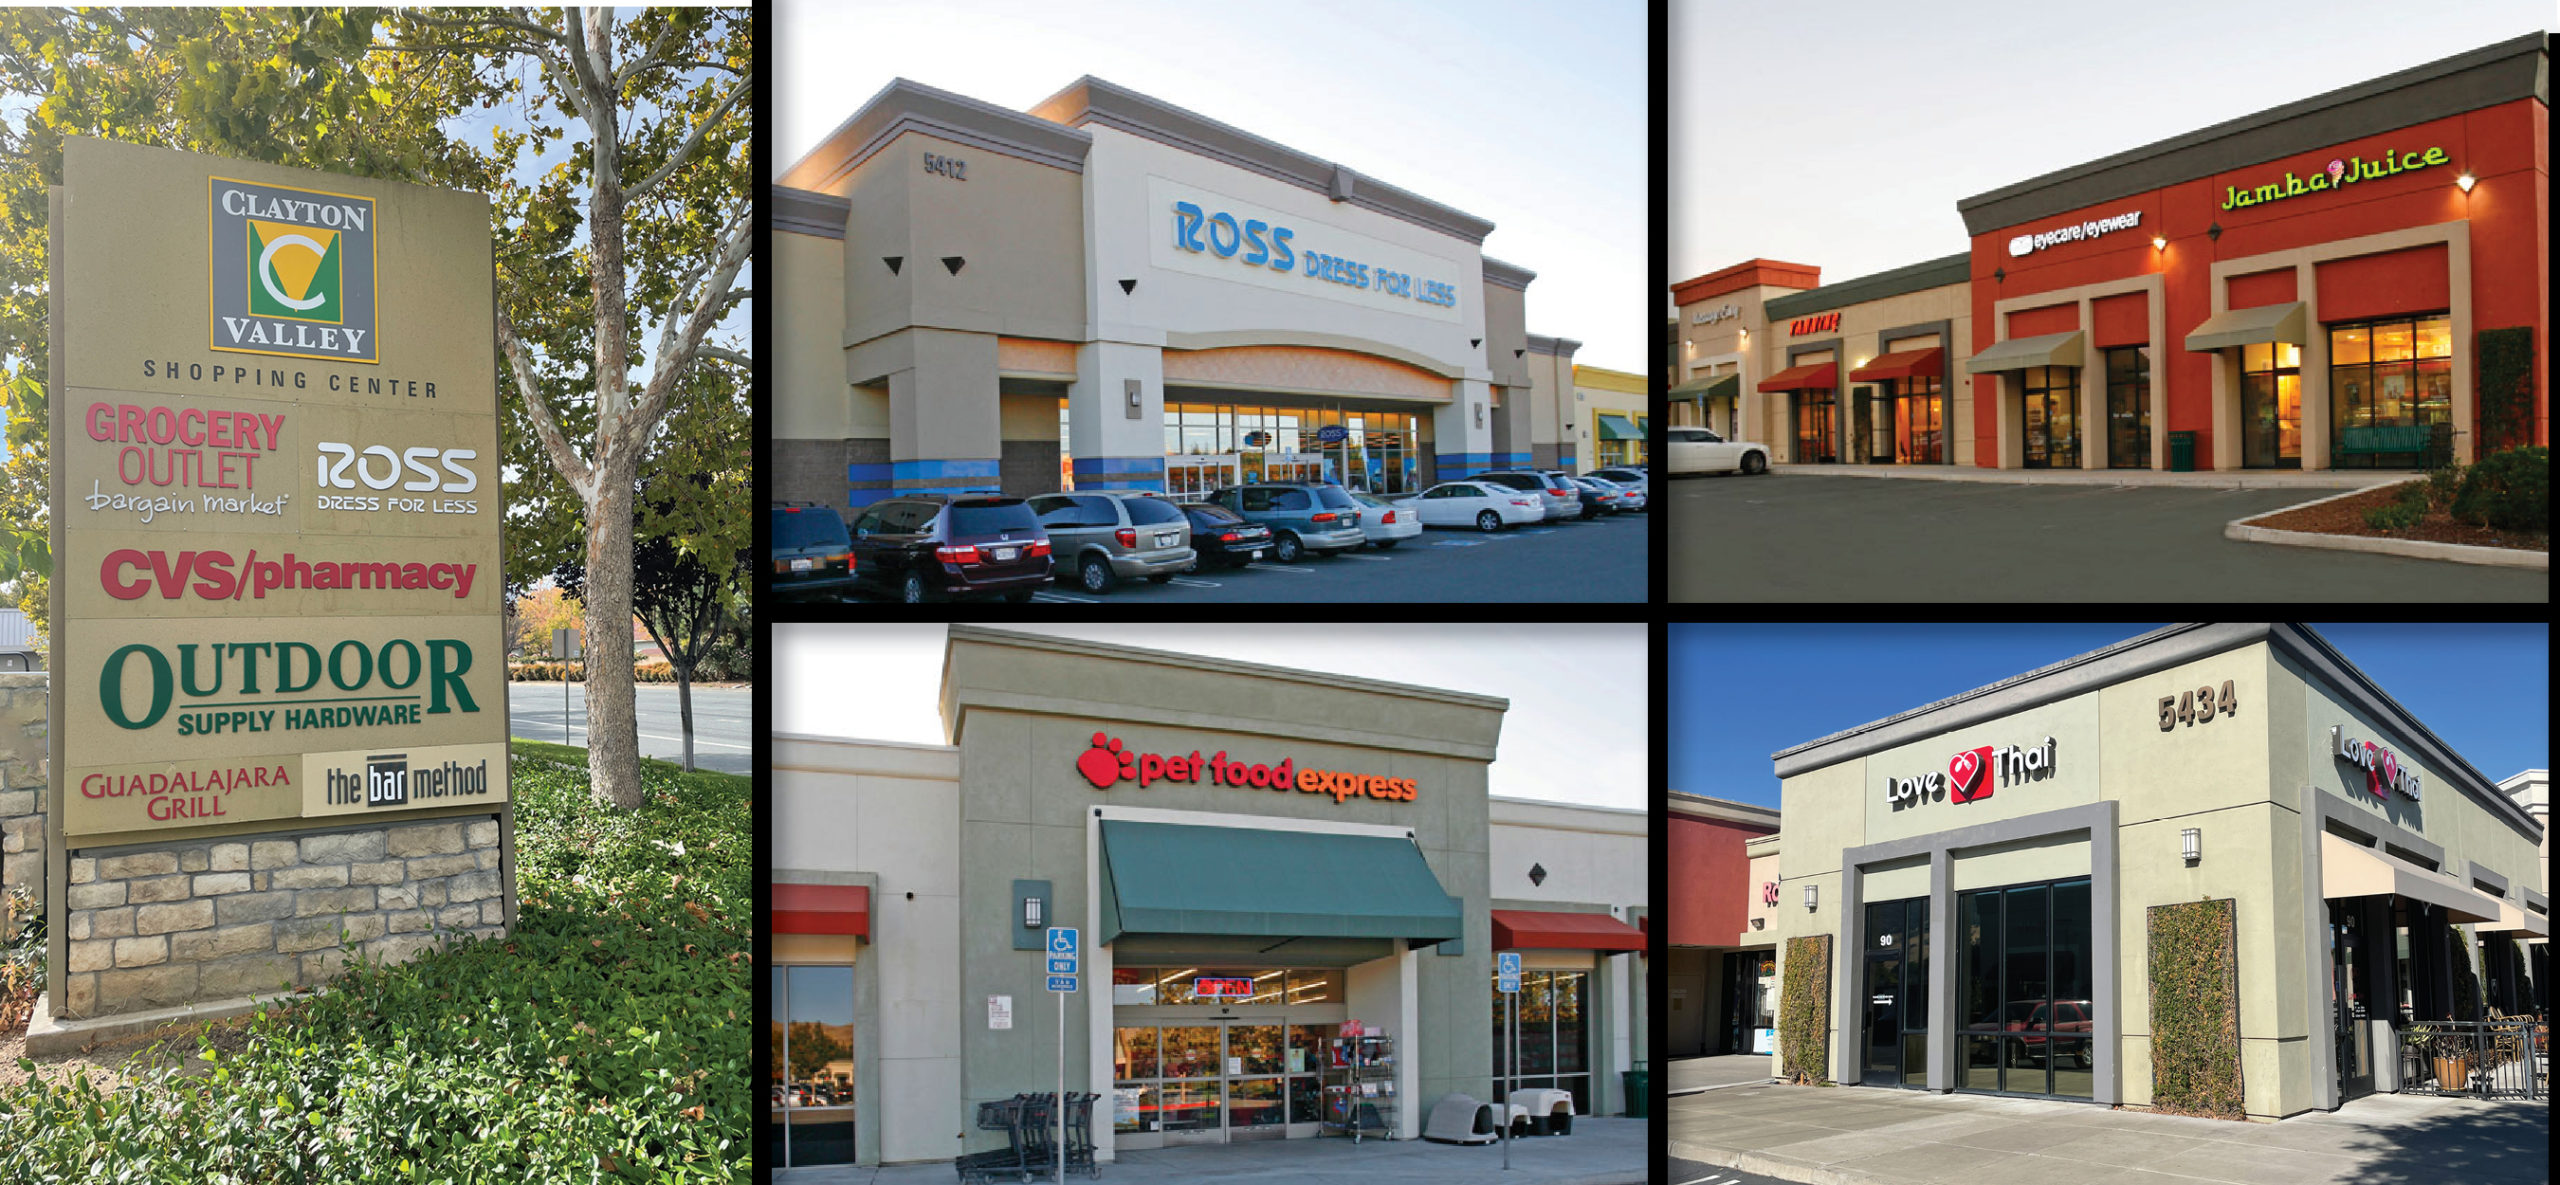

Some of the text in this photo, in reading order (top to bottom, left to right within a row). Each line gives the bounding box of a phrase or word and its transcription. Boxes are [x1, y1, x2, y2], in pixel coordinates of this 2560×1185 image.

[924, 152, 968, 181] 5412
[2222, 146, 2449, 210] Jamba Juice
[222, 189, 366, 232] CLAYTON
[2034, 210, 2142, 250] eyecare/eyewear
[1171, 201, 1456, 308] ROSS DRESS FOR LESS
[223, 316, 366, 354] VALLEY
[144, 359, 438, 399] SHOPPING CENTER
[86, 402, 286, 450] GROCERY
[118, 445, 260, 489] OUTLET
[318, 442, 477, 493] ROSS
[85, 479, 289, 524] bargain market
[318, 495, 478, 515] DRESS FOR LESS
[100, 549, 477, 600] CVS/pharmacy
[100, 638, 480, 730] OUTDOOR
[2159, 680, 2237, 731] 5434
[177, 704, 422, 736] SUPPLY HARDWARE
[1886, 735, 2052, 804] Love Thai
[2336, 724, 2376, 772] Love
[81, 764, 291, 800] GUADALAJARA
[327, 759, 487, 805] the bar method
[1139, 750, 1418, 804] pet food express
[147, 795, 227, 822] GRILL
[1880, 934, 1893, 946] 90
[1053, 961, 1071, 971] ONLY
[1197, 979, 1251, 996] OPEN
